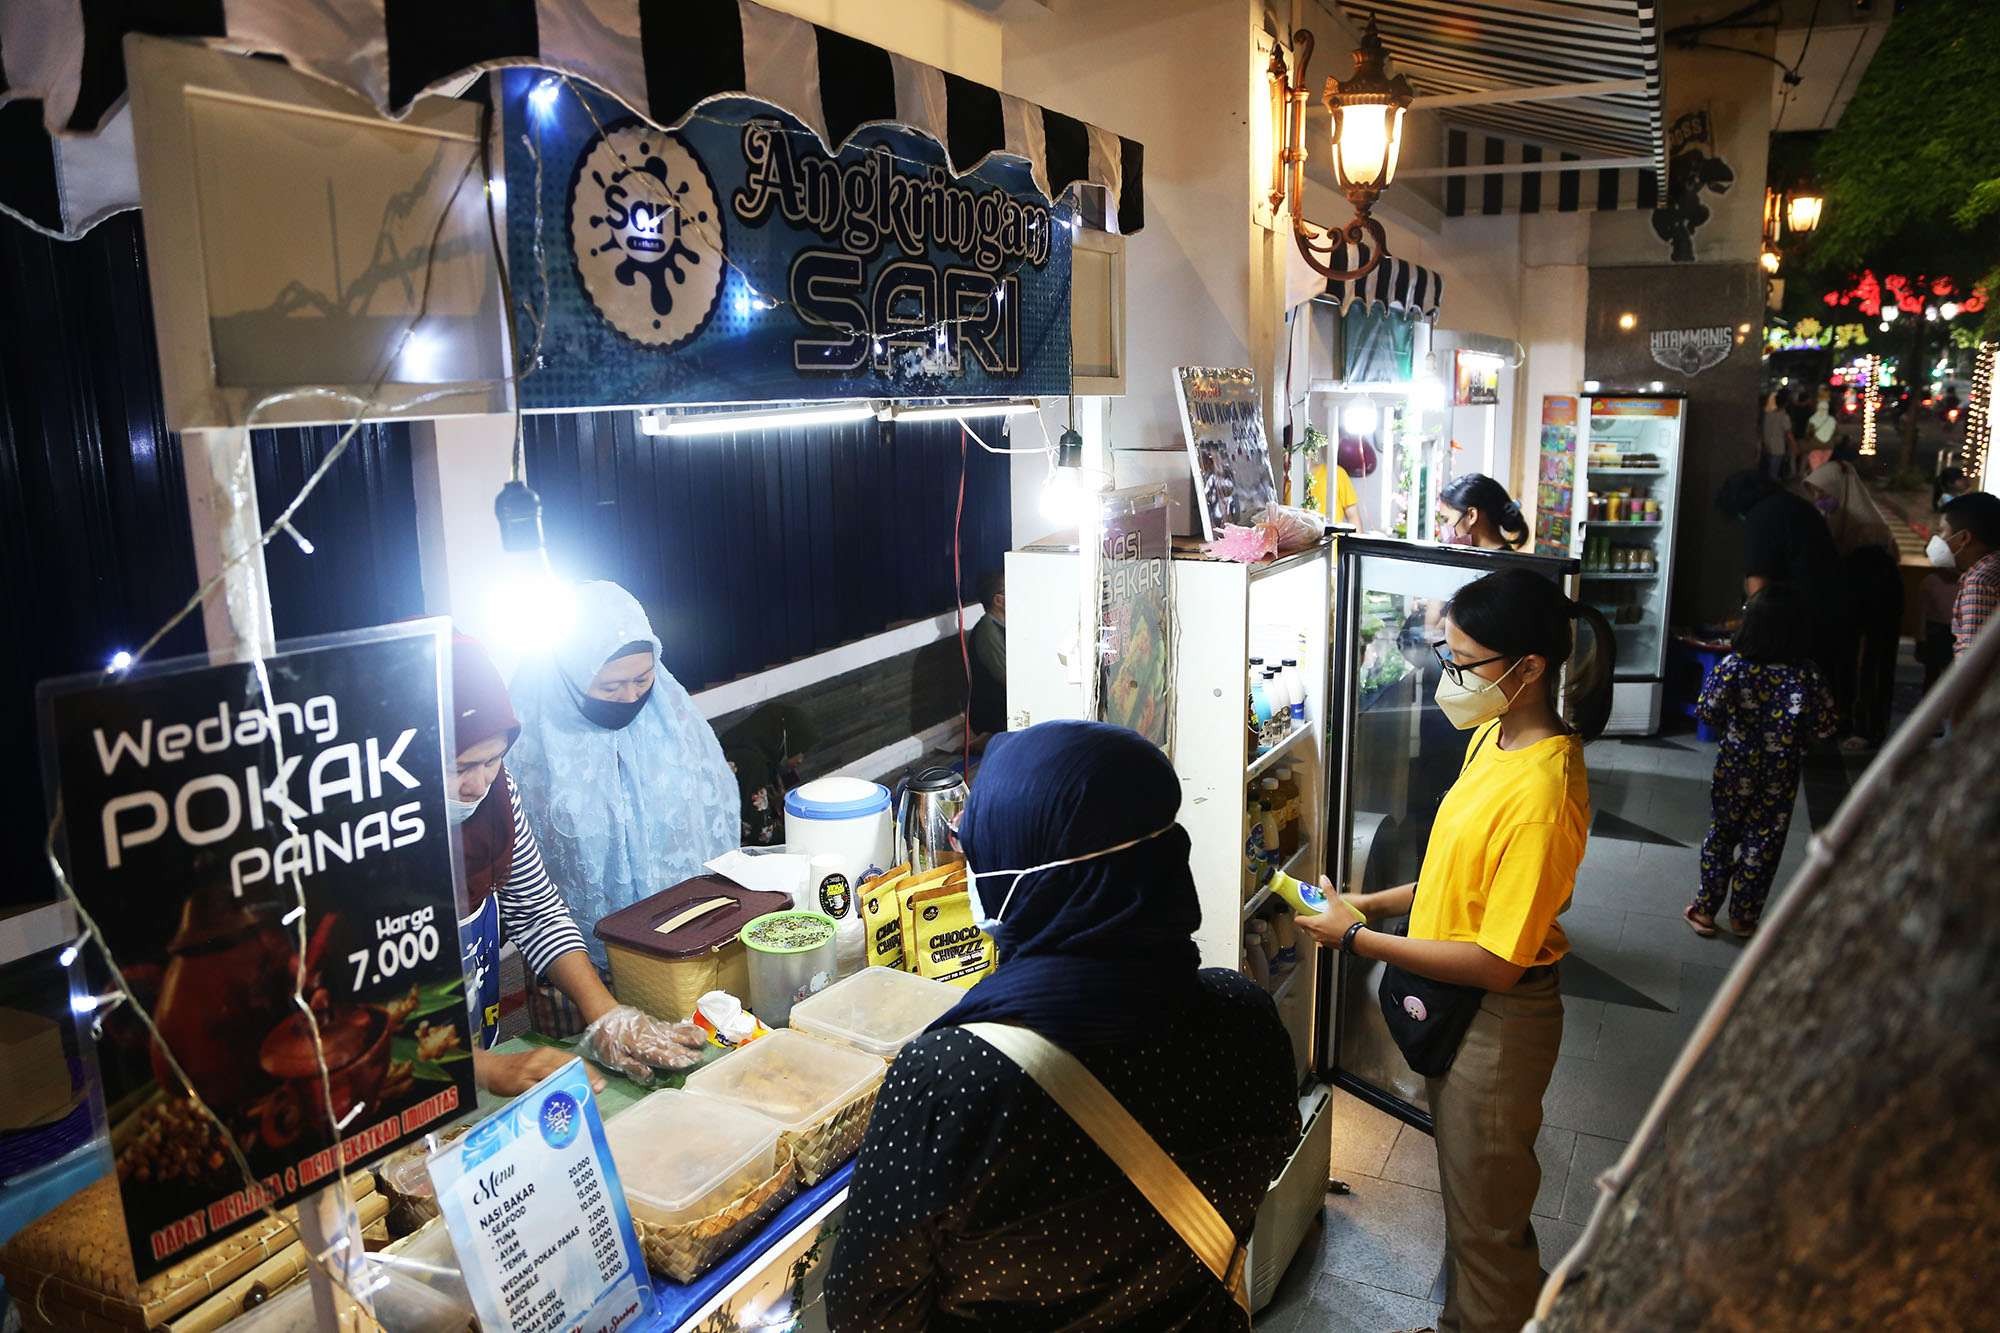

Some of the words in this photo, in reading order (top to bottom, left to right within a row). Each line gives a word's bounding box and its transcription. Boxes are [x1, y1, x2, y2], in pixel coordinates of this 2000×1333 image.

[605, 183, 681, 236] Sari
[734, 121, 1049, 272] Angkringan
[790, 251, 1020, 372] SARI
[1102, 557, 1161, 606] BAKAR
[1103, 530, 1142, 570] NASI
[94, 695, 337, 775] Wedang
[102, 728, 421, 869] POKAK
[230, 802, 426, 897] PANAS
[376, 905, 434, 939] Harga
[930, 925, 980, 949] CHOCO
[348, 925, 439, 992] 7.000
[151, 1209, 207, 1260] DAPAT
[298, 1115, 401, 1187] MENIGKATKAN
[401, 1084, 459, 1135] IMUNITAS
[473, 1163, 515, 1205] Menu
[492, 1205, 527, 1236] SEAFOOD
[568, 1156, 590, 1179] 20.000
[480, 1206, 503, 1230] NASI
[503, 1183, 535, 1212] BAKAR
[495, 1228, 517, 1249] TUNA
[499, 1240, 520, 1261] AYAM
[577, 1179, 598, 1200] 15.000
[503, 1249, 528, 1272] TEMPE
[580, 1190, 602, 1212] 10.000
[588, 1216, 609, 1238] 12.000
[592, 1227, 613, 1249] 12.000
[500, 1263, 534, 1293] WEDANG
[532, 1244, 558, 1269] POKAK
[557, 1225, 580, 1249] PANAS
[587, 1205, 606, 1224] 7.000
[511, 1305, 538, 1331] POKAK
[537, 1288, 557, 1310] SUSU
[595, 1238, 616, 1260] 12.000
[541, 1298, 566, 1322] BOTOL
